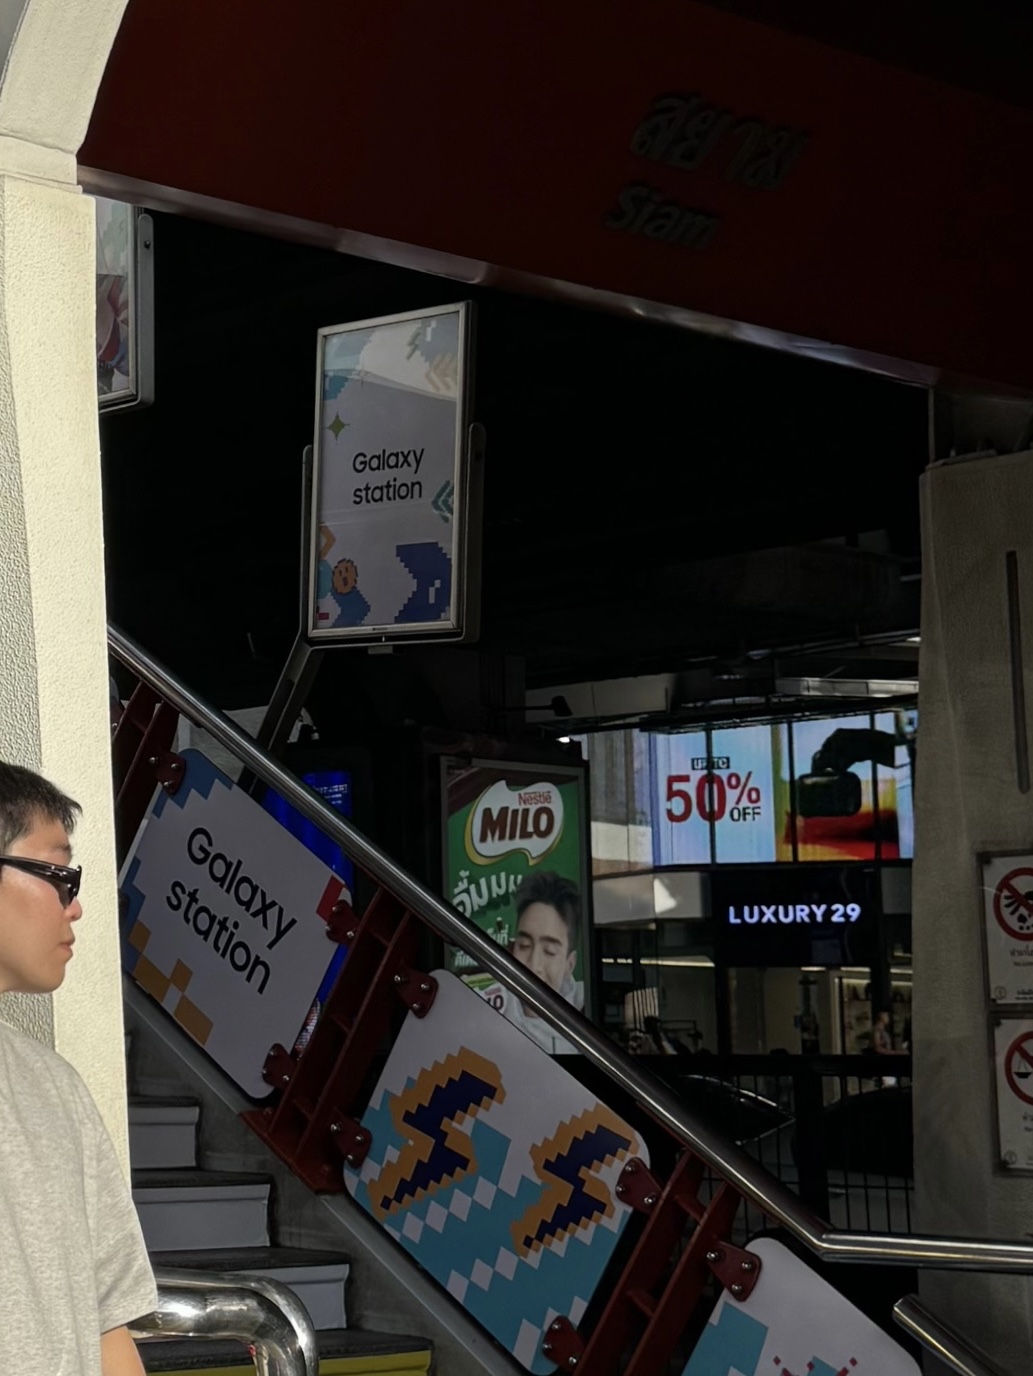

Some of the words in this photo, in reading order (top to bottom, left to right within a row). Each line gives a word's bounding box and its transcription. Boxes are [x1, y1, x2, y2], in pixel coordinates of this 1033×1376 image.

[605, 184, 719, 250] Siam
[352, 448, 425, 475] Galaxy
[352, 477, 423, 505] station
[666, 770, 761, 823] 50%
[729, 806, 761, 822] OFF
[479, 806, 554, 843] MILO
[186, 827, 298, 950] Galaxy
[728, 904, 827, 924] LUXURY
[830, 903, 861, 922] 29
[165, 880, 271, 995] station
